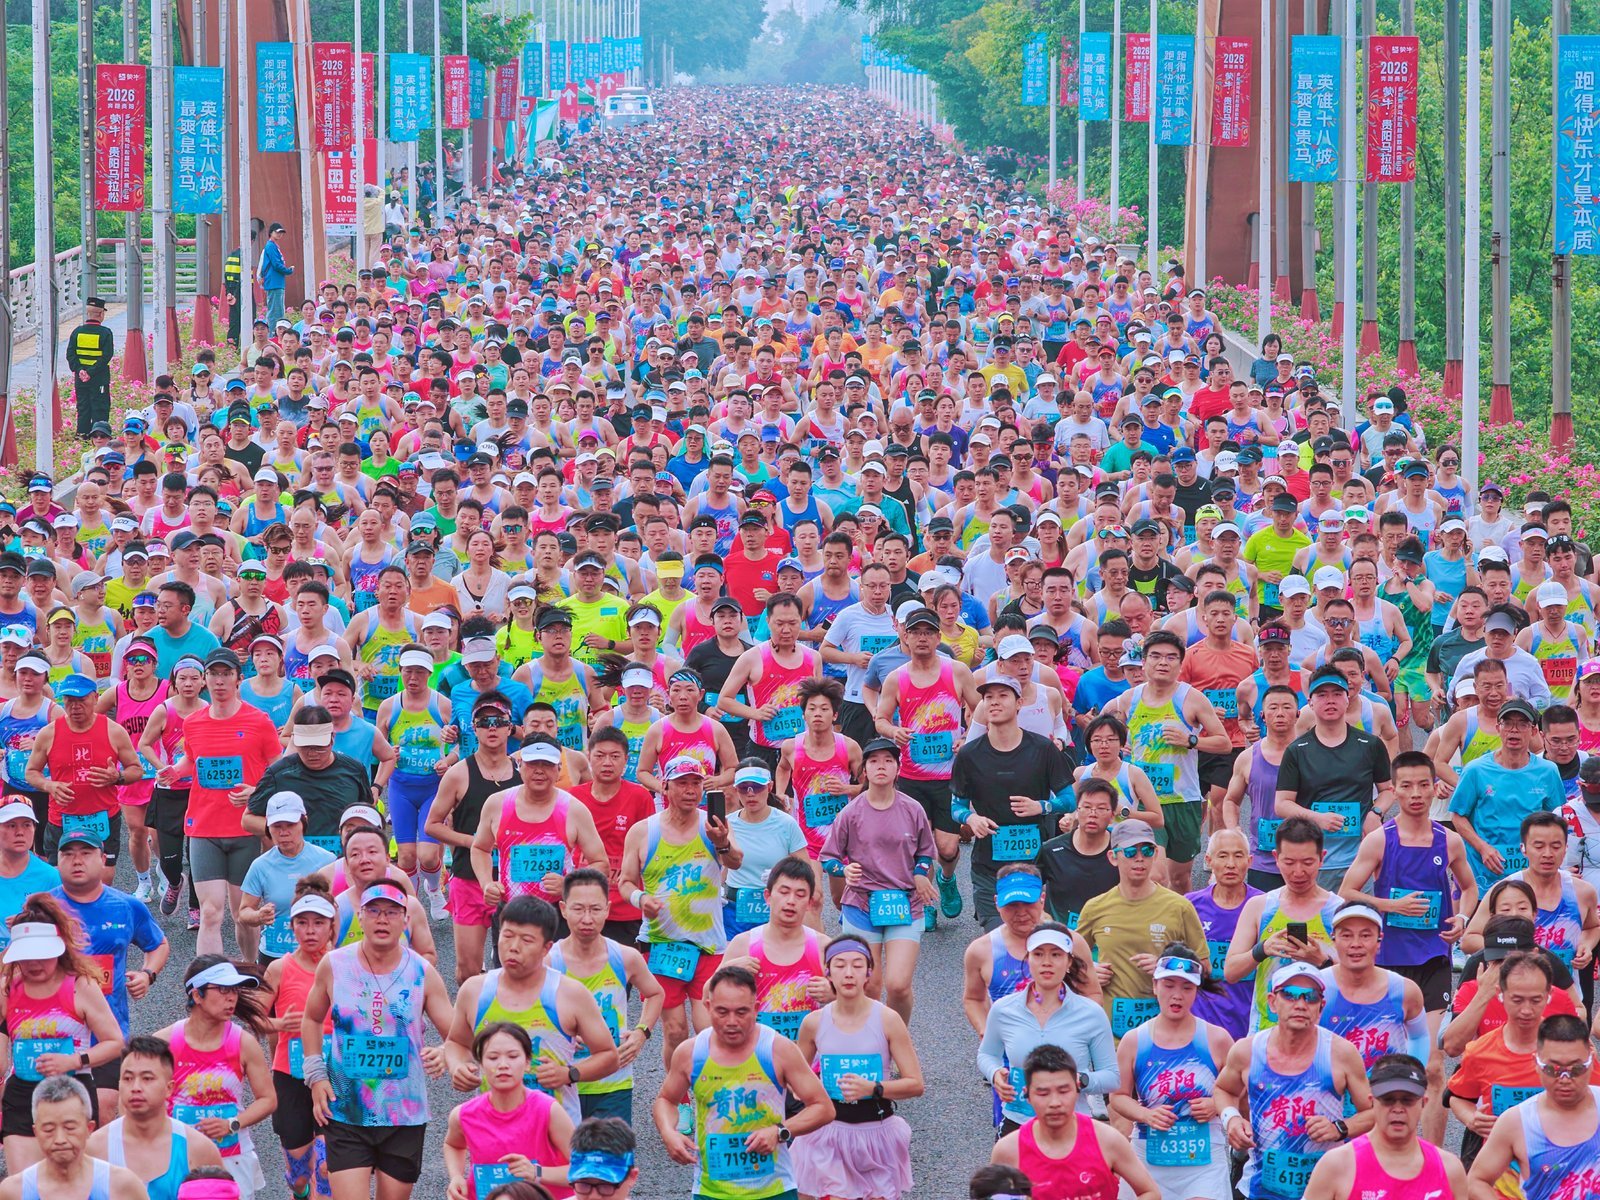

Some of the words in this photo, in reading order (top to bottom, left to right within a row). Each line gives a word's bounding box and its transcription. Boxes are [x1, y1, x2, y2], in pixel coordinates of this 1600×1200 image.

[322, 60, 343, 70] 2026
[1223, 53, 1244, 64] 2026
[1380, 61, 1408, 75] 2026
[1174, 50, 1188, 118] 跑得快是本事
[107, 88, 135, 102] 2026
[276, 59, 287, 127] 跑得快是本事
[1160, 50, 1174, 141] 跑得快乐才是本质
[264, 59, 276, 149] 跑得快乐才是本质
[1295, 74, 1313, 164] 最爽是贵马
[1315, 74, 1334, 165] 英雄十八坡
[179, 100, 196, 192] 最爽是贵马
[200, 100, 217, 192] 英雄十八坡
[1572, 70, 1594, 251] 跑得快乐才是本质
[95, 662, 109, 671] 538
[1550, 669, 1573, 678] 70118
[774, 718, 802, 731] 61550
[561, 736, 580, 747] 016
[922, 744, 948, 755] 61123
[11, 753, 16, 762] F
[198, 758, 204, 768] E
[406, 756, 436, 767] 75648
[75, 747, 91, 782] 北京
[207, 769, 240, 780] 62532
[1151, 776, 1170, 786] 929
[805, 798, 811, 807] E
[64, 816, 71, 824] E
[1003, 838, 1039, 851] 72038
[513, 848, 520, 857] F
[523, 859, 561, 872] 72633
[658, 863, 702, 893] 贵阳
[739, 890, 745, 899] F
[747, 902, 770, 913] 762
[878, 904, 910, 916] 63108
[660, 953, 692, 971] 71981
[372, 991, 382, 1035] NEDAO
[1116, 1001, 1124, 1012] E
[16, 1042, 23, 1053] F
[292, 1041, 298, 1052] F
[347, 1038, 355, 1050] F
[358, 1054, 404, 1068] 72770
[823, 1058, 830, 1070] F
[1012, 1070, 1019, 1083] E
[1149, 1069, 1195, 1099] 贵阳
[1494, 1088, 1501, 1099] F
[706, 1086, 758, 1122] 贵阳
[175, 1108, 184, 1119] F
[1262, 1094, 1317, 1134] 贵阳
[1179, 1125, 1198, 1135] 蒙牛
[709, 1137, 717, 1149] F
[1160, 1139, 1206, 1154] 63359
[1266, 1151, 1276, 1165] E
[475, 1167, 482, 1180] F
[1279, 1169, 1314, 1185] 6138
